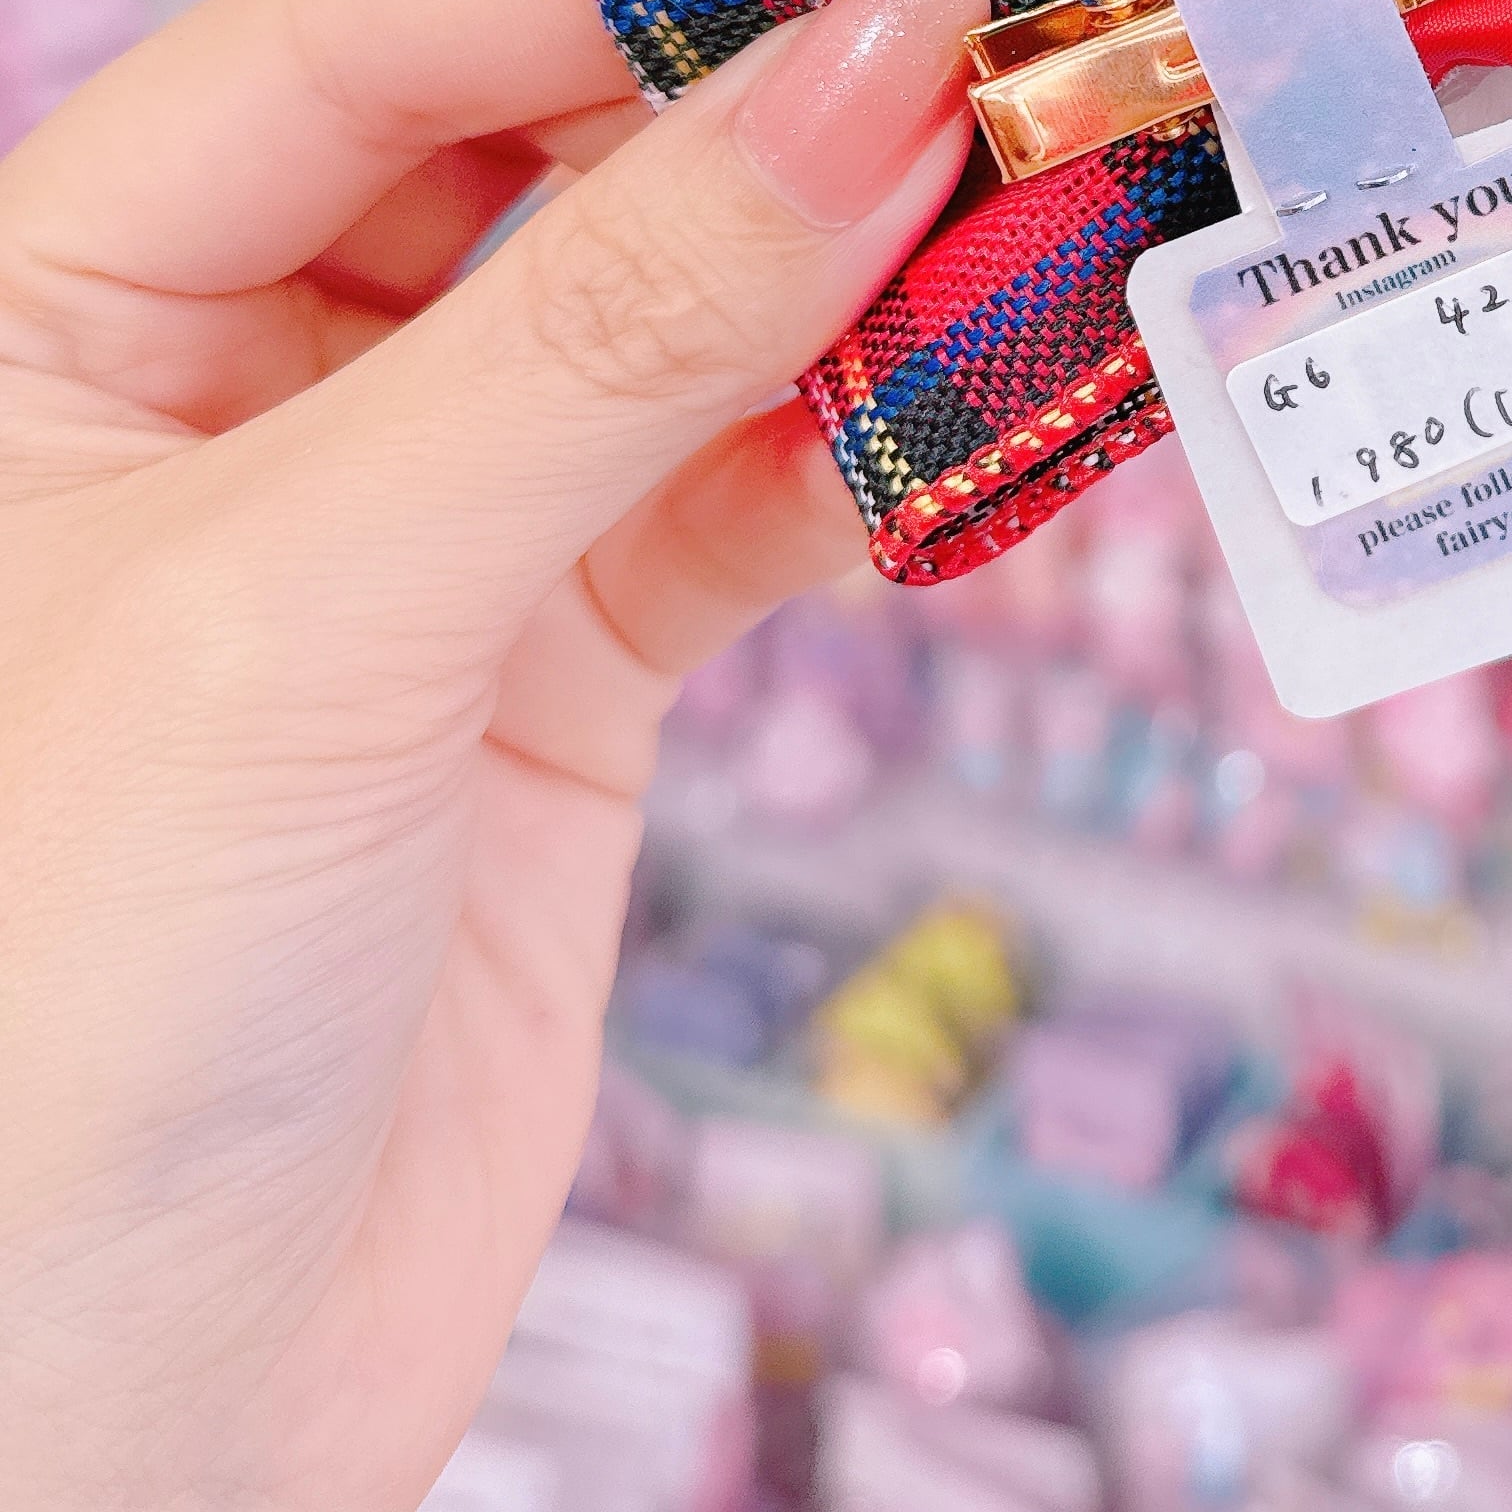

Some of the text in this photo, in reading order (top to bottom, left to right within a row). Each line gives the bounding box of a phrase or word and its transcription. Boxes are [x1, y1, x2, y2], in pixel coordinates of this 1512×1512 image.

[1238, 211, 1422, 308] Thank
[1335, 250, 1458, 311] Instagram
[1358, 497, 1454, 557] please
